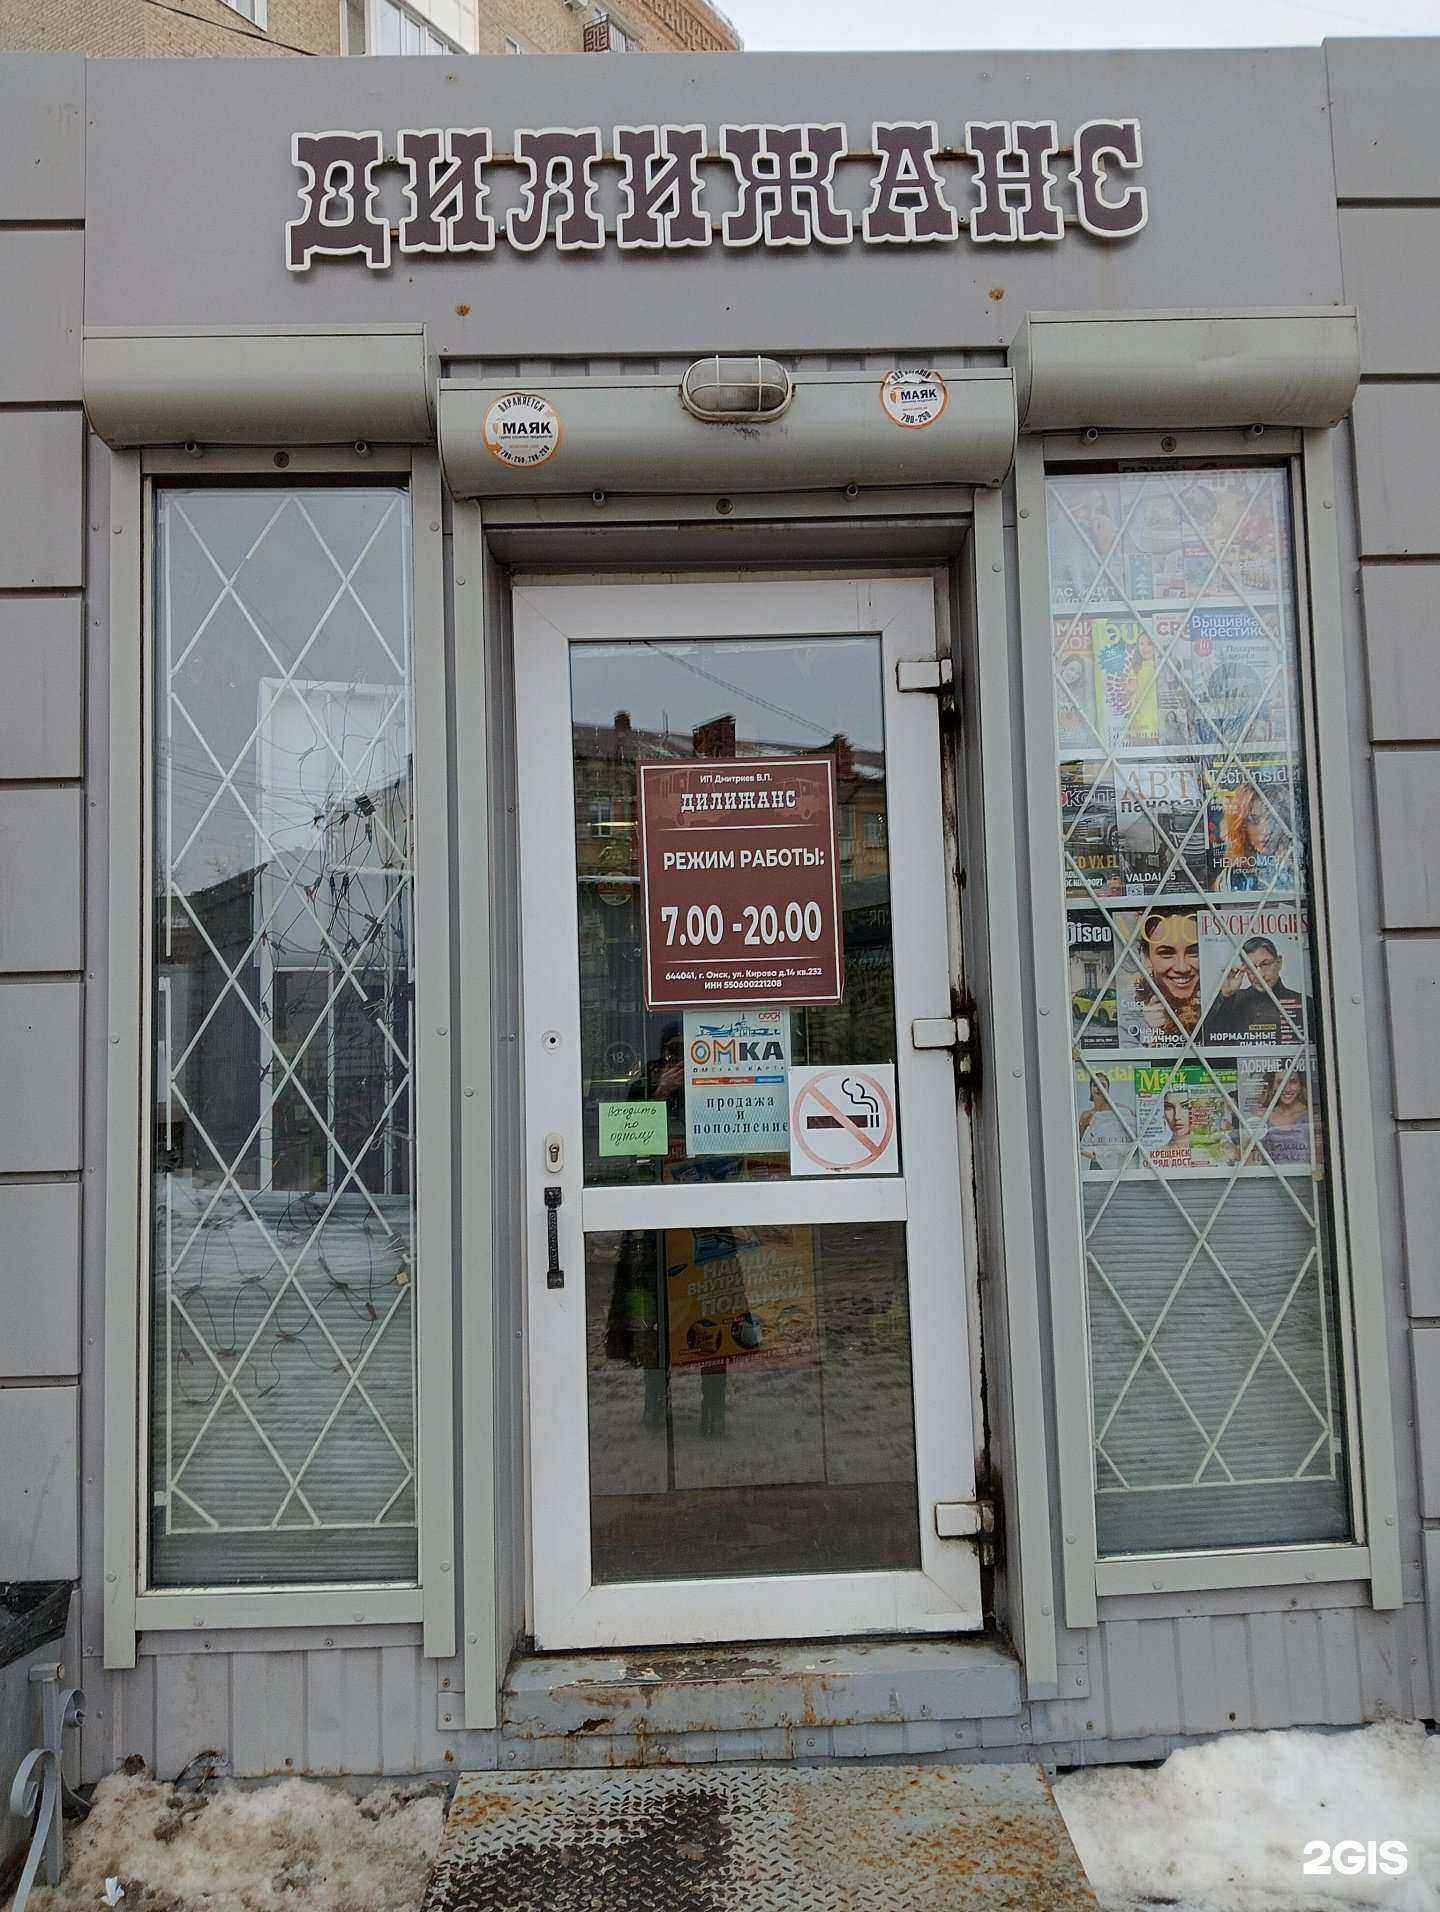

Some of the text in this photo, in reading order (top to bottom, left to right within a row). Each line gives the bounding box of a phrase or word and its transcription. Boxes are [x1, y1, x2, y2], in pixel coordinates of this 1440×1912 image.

[286, 118, 1149, 271] ДИЛИЖАНС
[901, 388, 938, 401] МАЯК
[497, 396, 546, 413] ОХРАНЯЕТСЯ
[502, 422, 552, 435] МАЯК
[700, 772, 773, 785] ИП Дмитриев В.П.
[681, 790, 796, 813] ДИЛИЖАНС
[663, 847, 825, 870] РЕЖИМ РАБОТЫ:
[1125, 872, 1162, 883] VALDAI
[661, 904, 724, 946] 7.00
[706, 971, 731, 980] Омск,
[704, 981, 722, 990] ИНН
[1209, 1032, 1277, 1042] НОРМАЛЬНЫЕ
[690, 1039, 785, 1065] ОМКА
[1241, 1060, 1283, 1074] ДОБРЫЕ
[707, 1096, 775, 1111] продажа
[736, 1110, 745, 1120] и
[624, 1121, 639, 1129] по
[693, 1121, 788, 1134] пополнение
